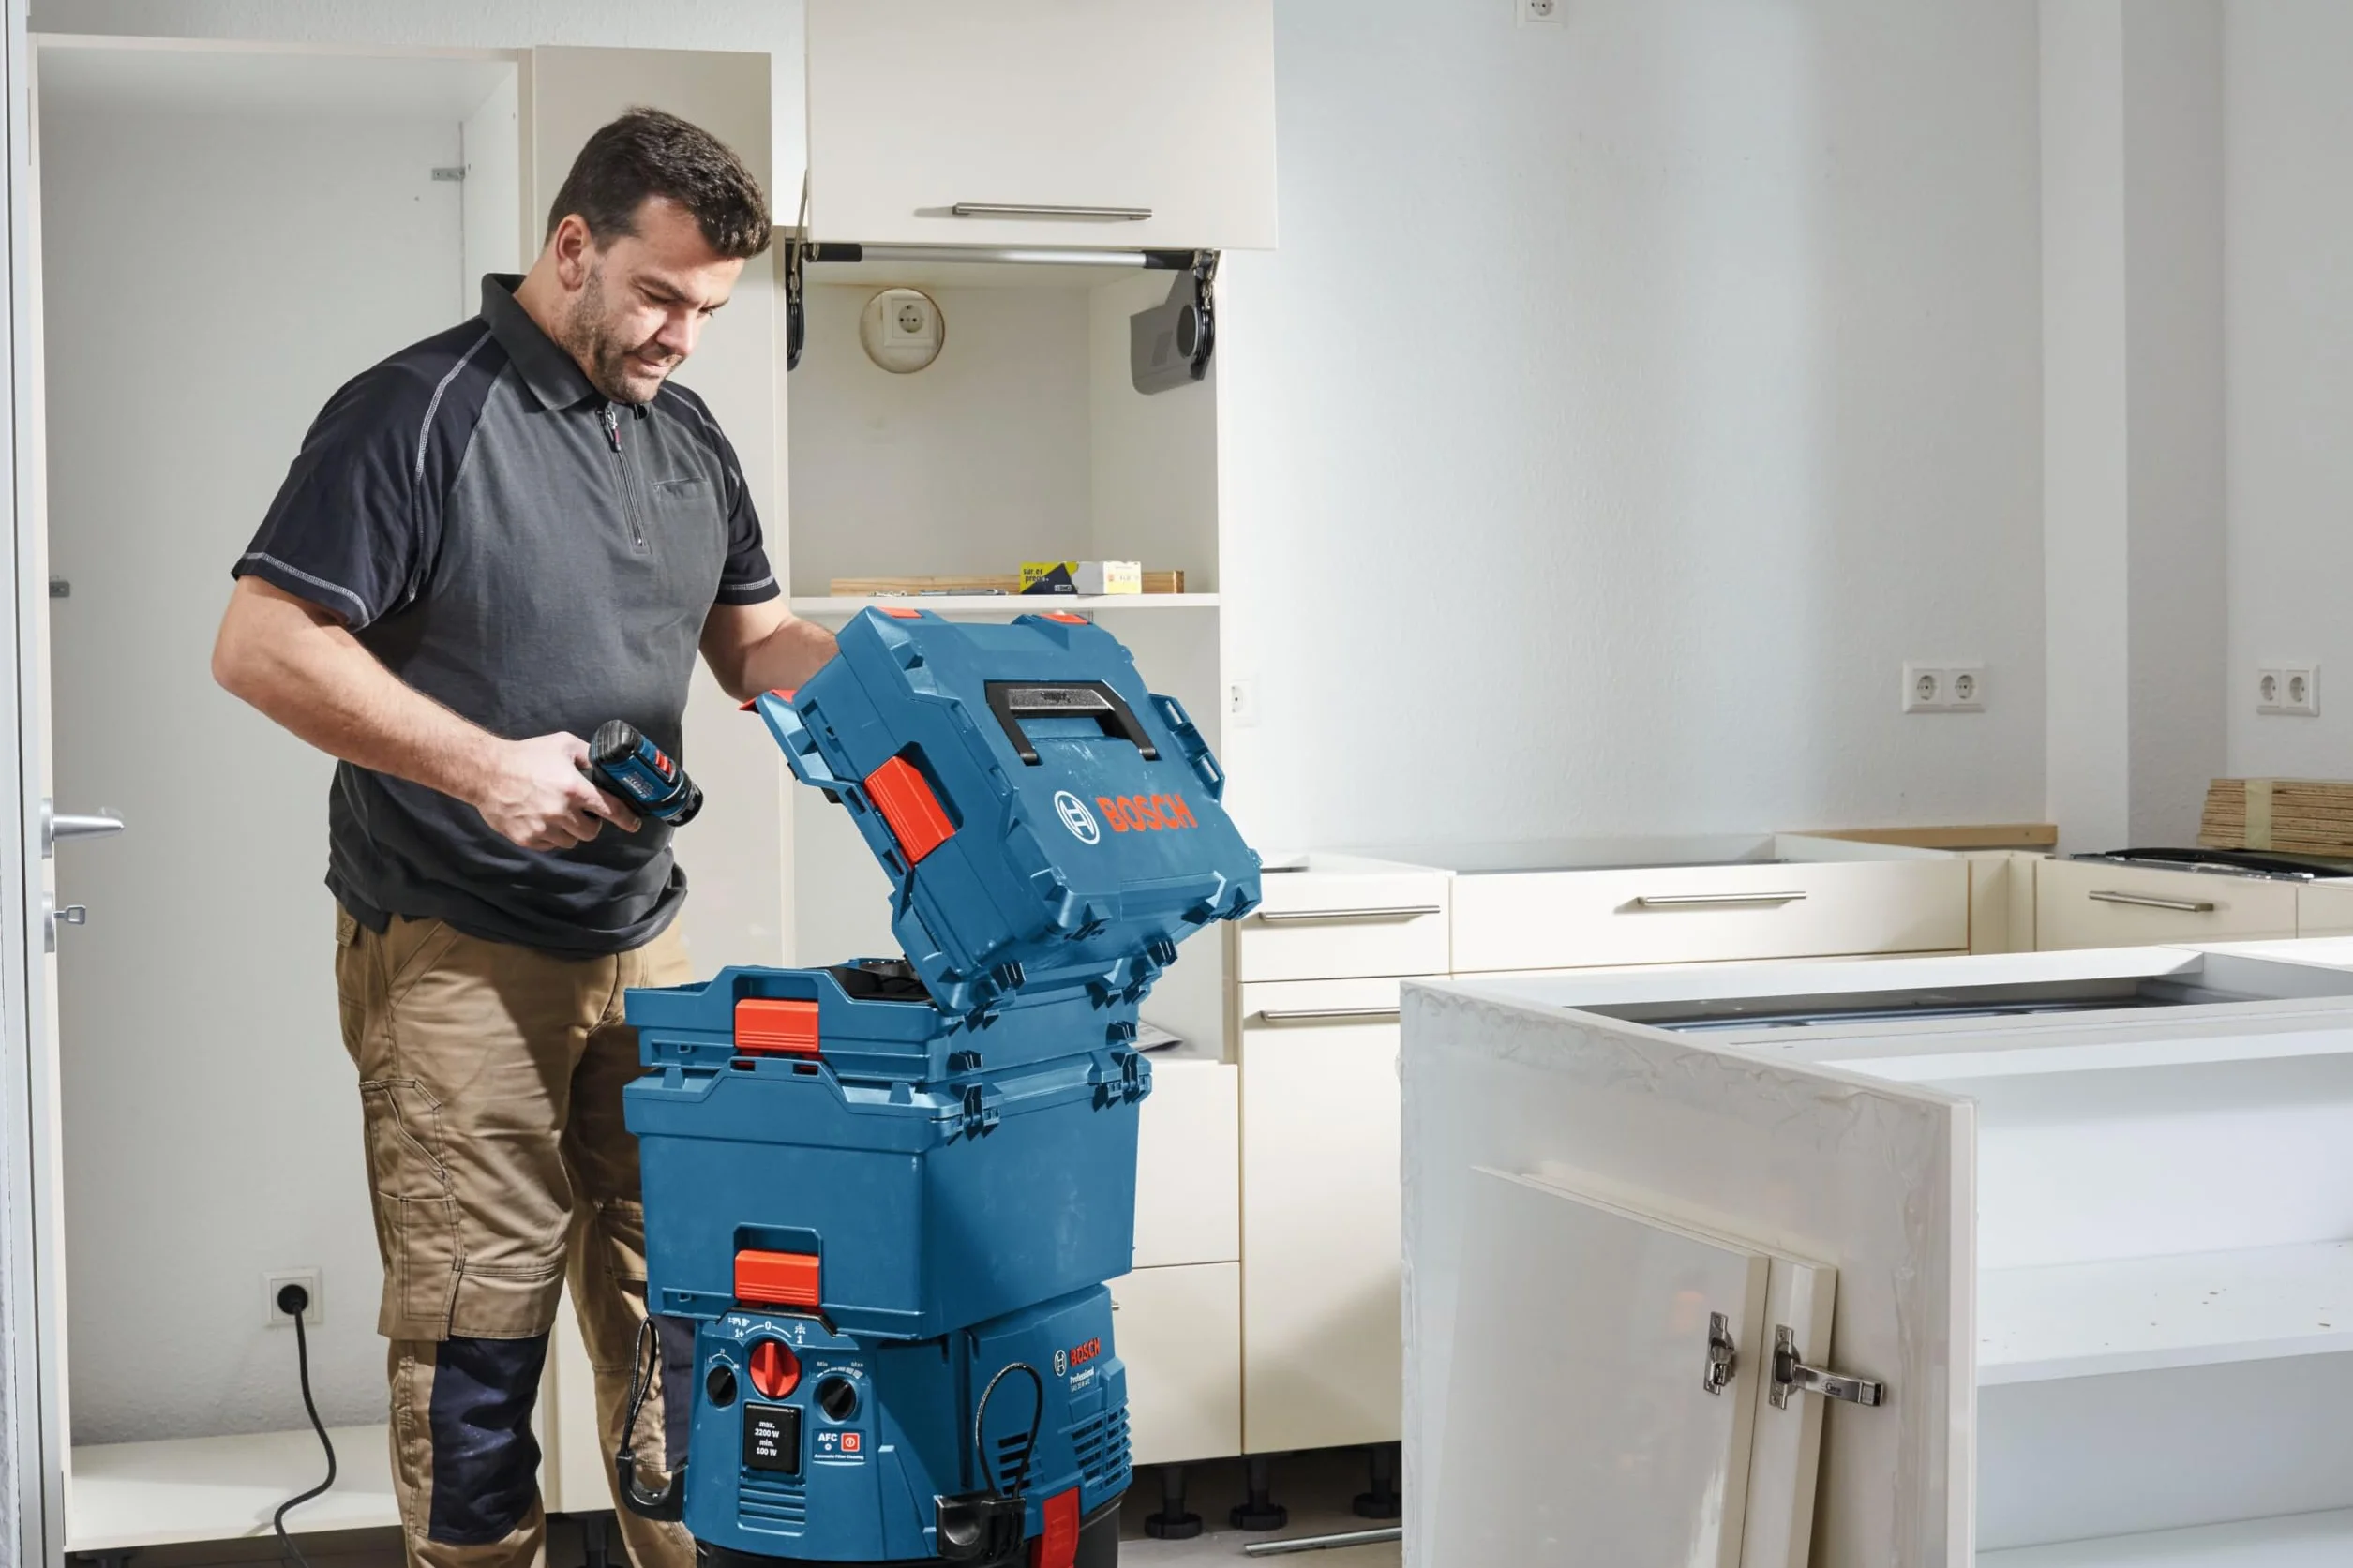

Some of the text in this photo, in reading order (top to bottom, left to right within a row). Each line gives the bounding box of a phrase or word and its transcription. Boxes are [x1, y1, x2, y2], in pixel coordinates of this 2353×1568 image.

[1095, 794, 1198, 832] BOSCH
[764, 1321, 772, 1331] 0
[796, 1335, 803, 1344] 1
[1071, 1337, 1101, 1367] BOSCH
[758, 1420, 776, 1429] max.
[754, 1427, 780, 1439] 2200 W
[817, 1432, 838, 1442] AFC
[758, 1438, 774, 1447] min.
[756, 1446, 778, 1457] 100 W
